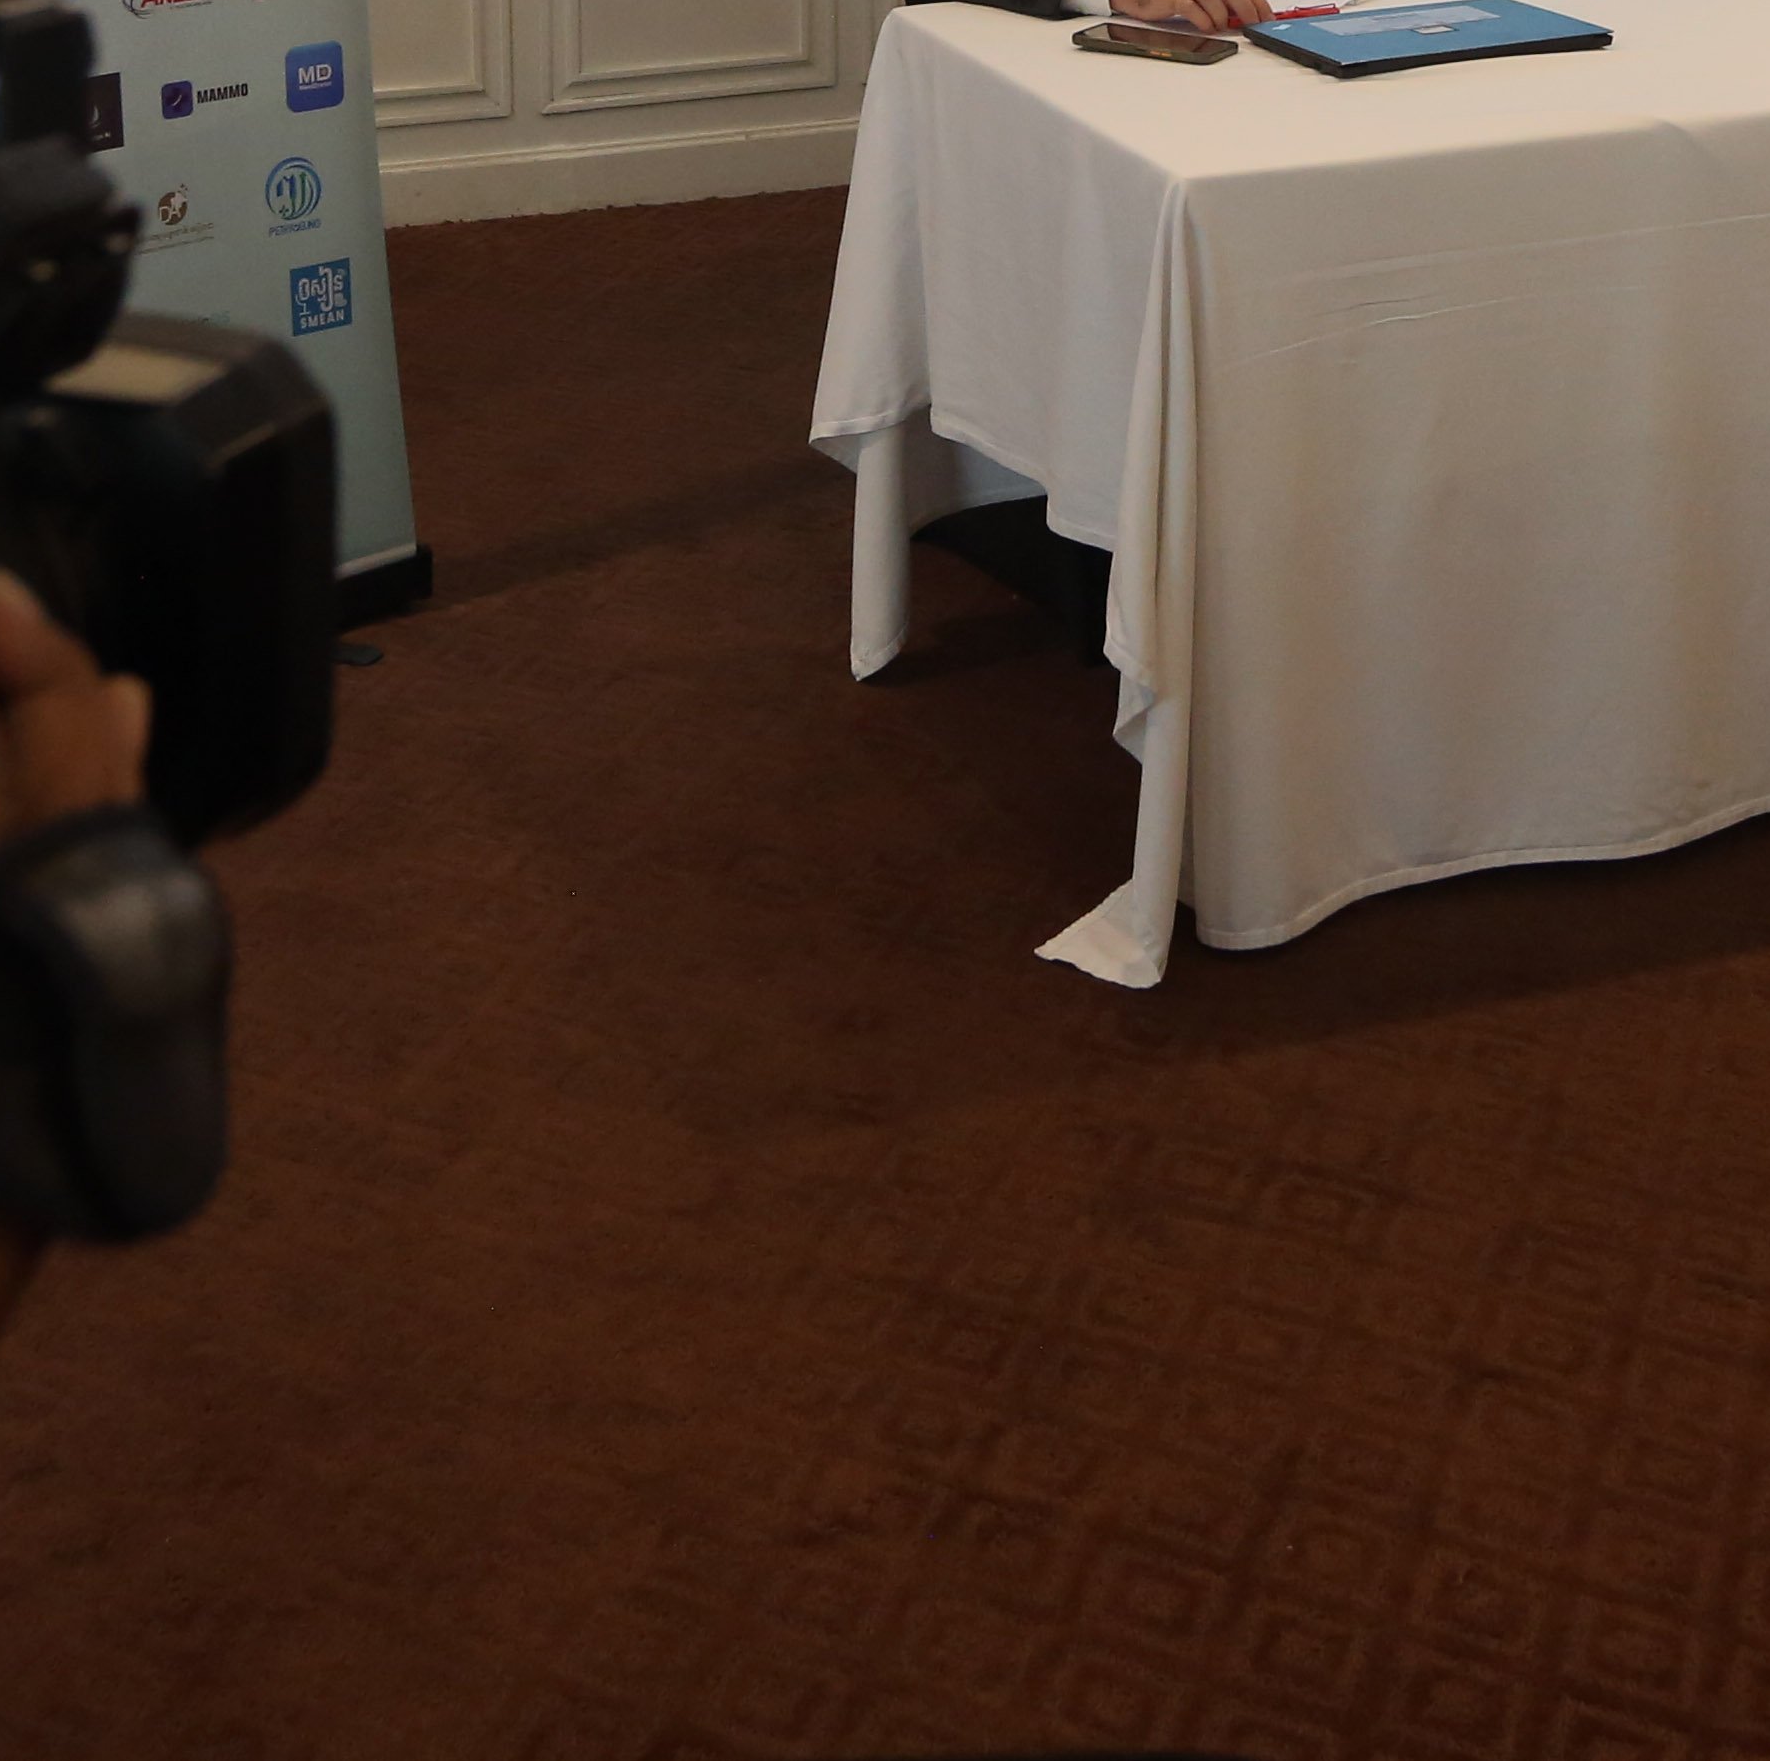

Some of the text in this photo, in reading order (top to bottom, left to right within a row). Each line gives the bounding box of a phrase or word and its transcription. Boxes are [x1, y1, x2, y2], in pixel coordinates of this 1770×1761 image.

[299, 64, 332, 84] MD
[197, 83, 249, 104] MAMMO
[300, 309, 345, 329] SMEAN
